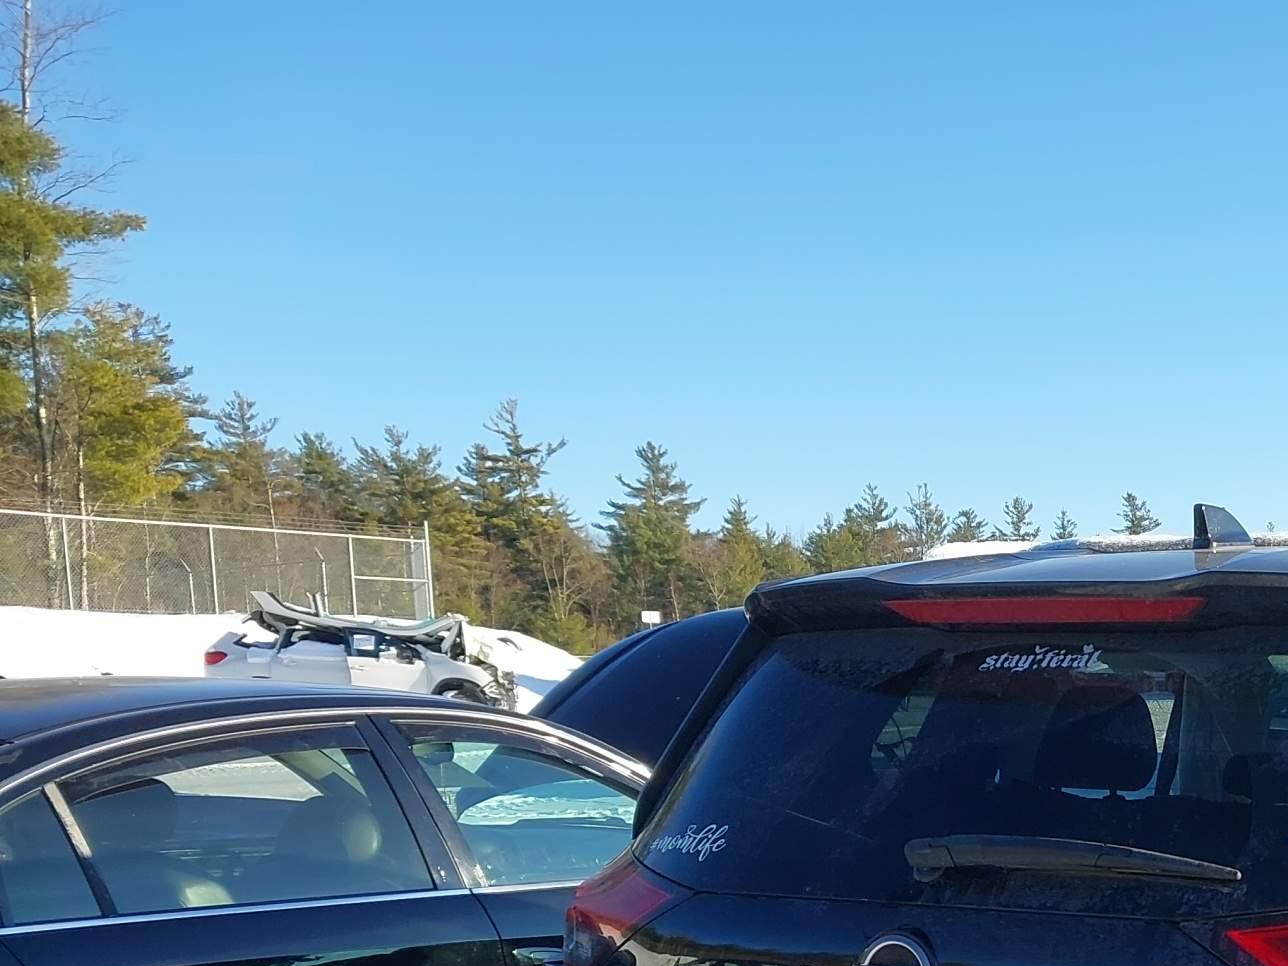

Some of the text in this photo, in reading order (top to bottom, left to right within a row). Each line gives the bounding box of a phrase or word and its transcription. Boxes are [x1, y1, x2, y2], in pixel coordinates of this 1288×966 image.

[979, 646, 1104, 673] stay feral
[650, 824, 729, 862] #momlife
